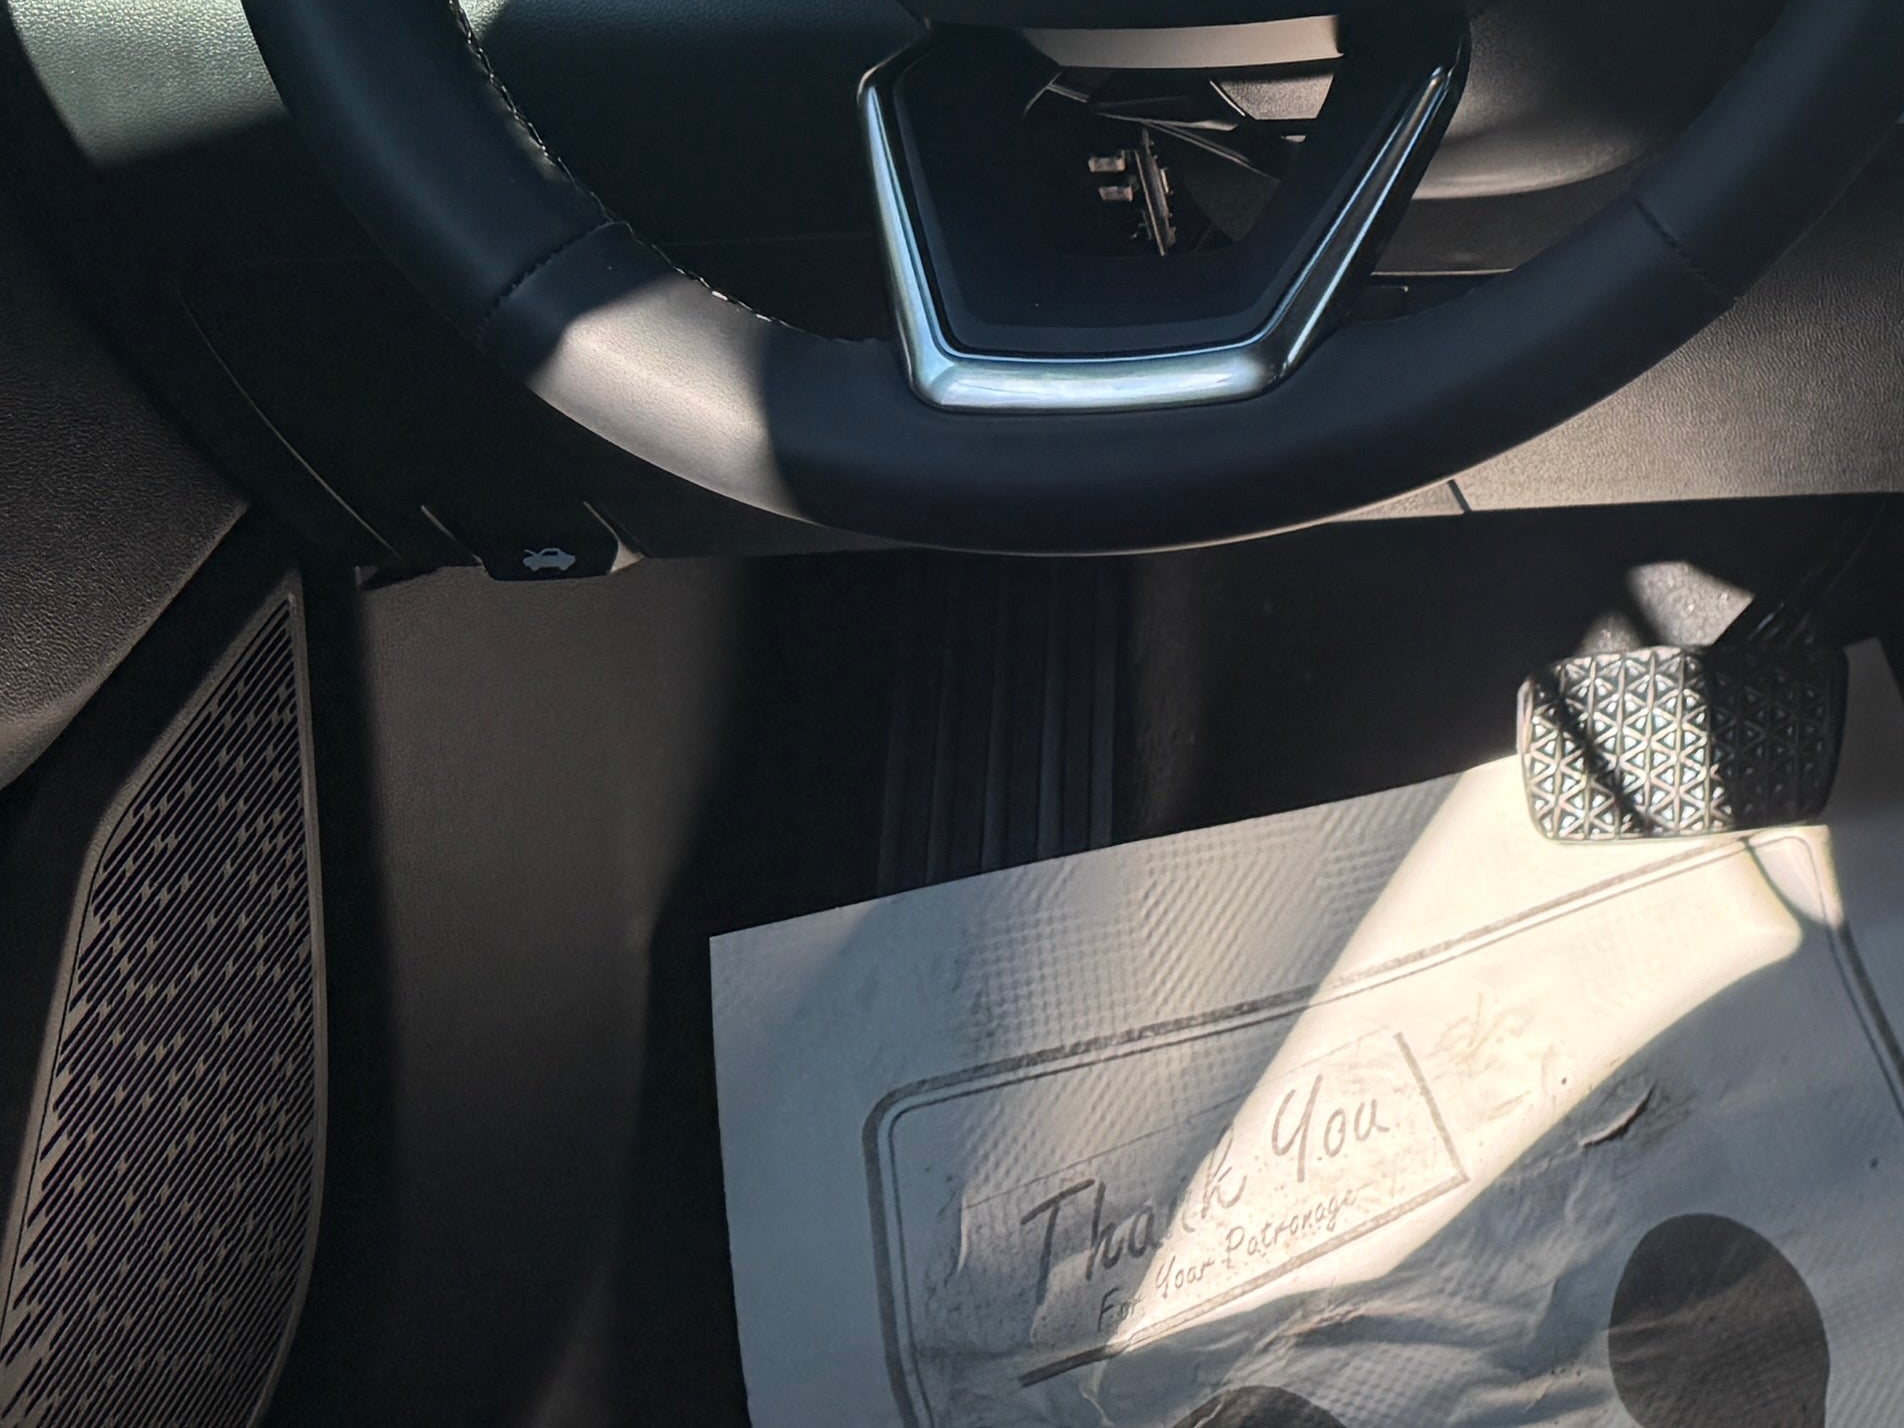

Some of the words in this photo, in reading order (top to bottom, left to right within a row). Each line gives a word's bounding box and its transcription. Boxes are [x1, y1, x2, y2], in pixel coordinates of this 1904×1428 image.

[1020, 1122, 1248, 1306] Thank
[1271, 1074, 1390, 1183] You
[1097, 1286, 1142, 1333] For
[1224, 1187, 1358, 1270] Patronage
